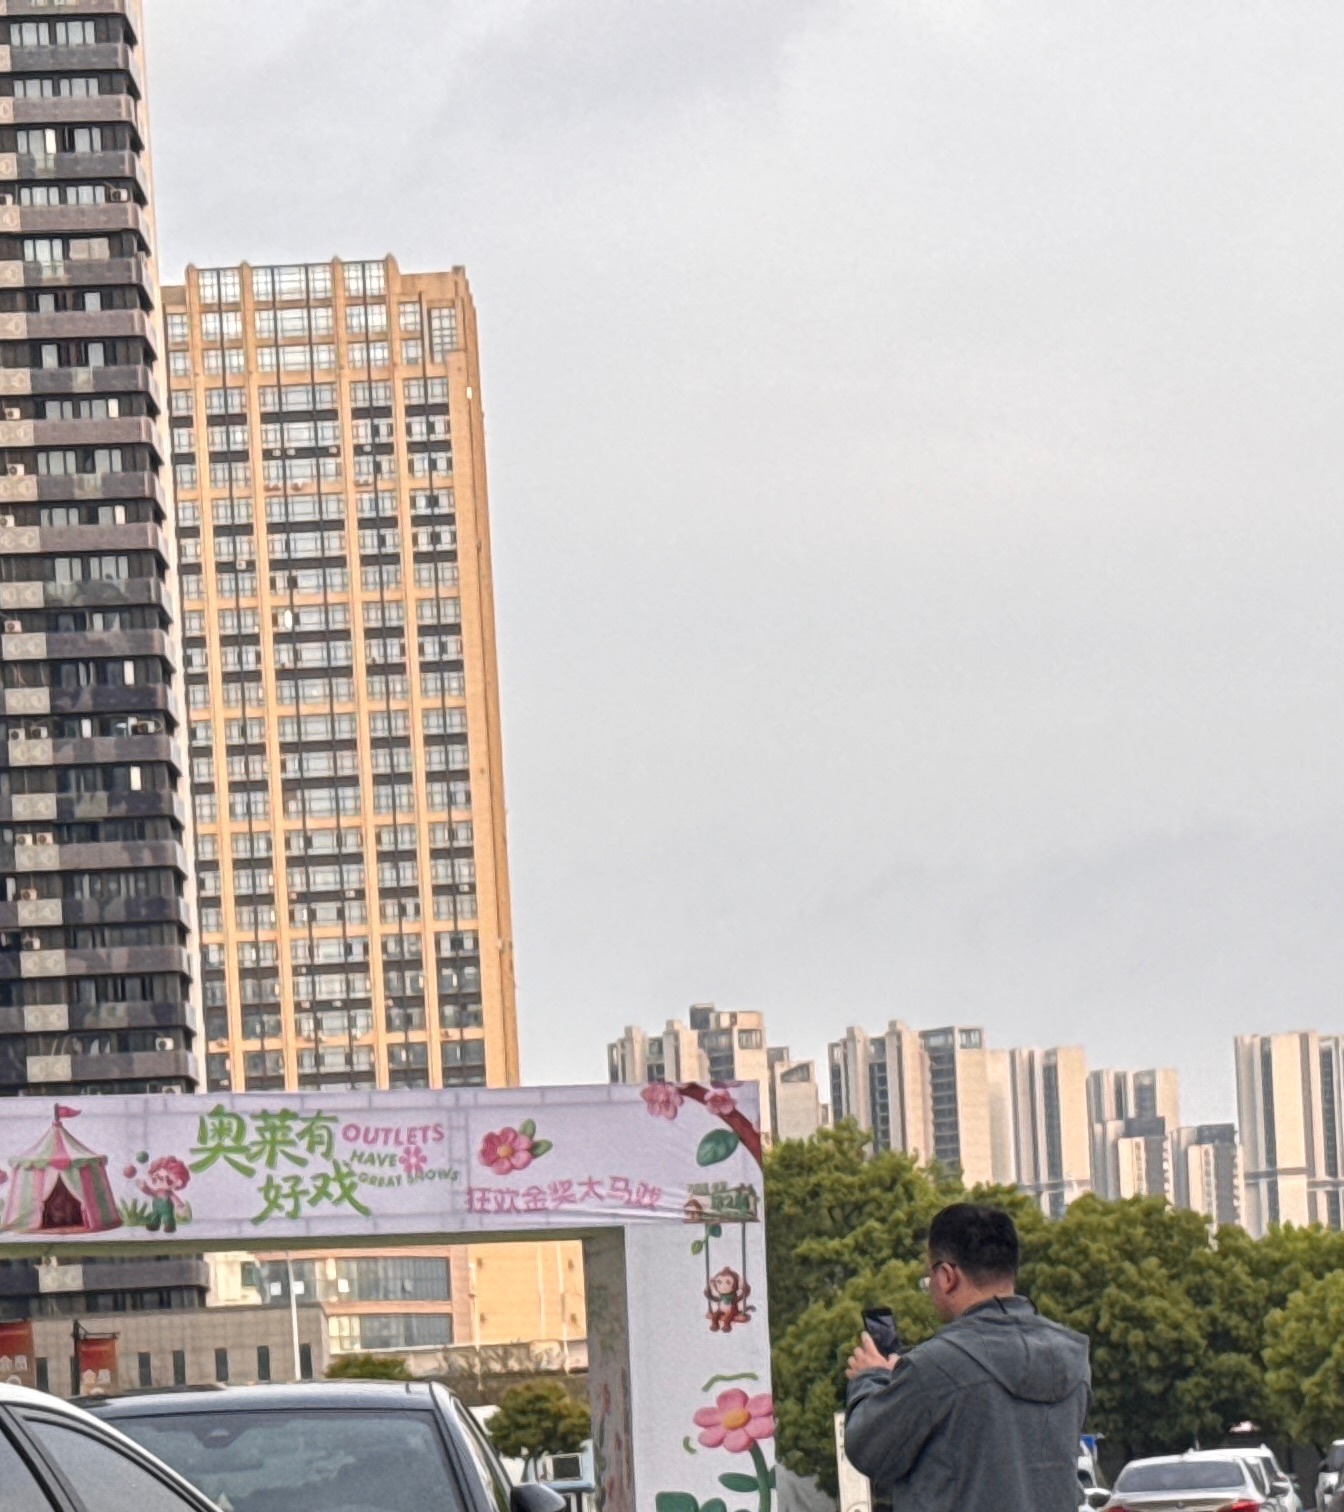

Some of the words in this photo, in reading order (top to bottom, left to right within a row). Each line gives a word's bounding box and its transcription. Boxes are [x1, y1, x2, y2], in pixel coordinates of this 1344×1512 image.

[189, 1104, 338, 1178] 奥莱有
[342, 1123, 445, 1145] OUTLETS
[350, 1150, 398, 1168] HAVE
[358, 1172, 402, 1188] GREAT
[250, 1158, 372, 1225] 好戏
